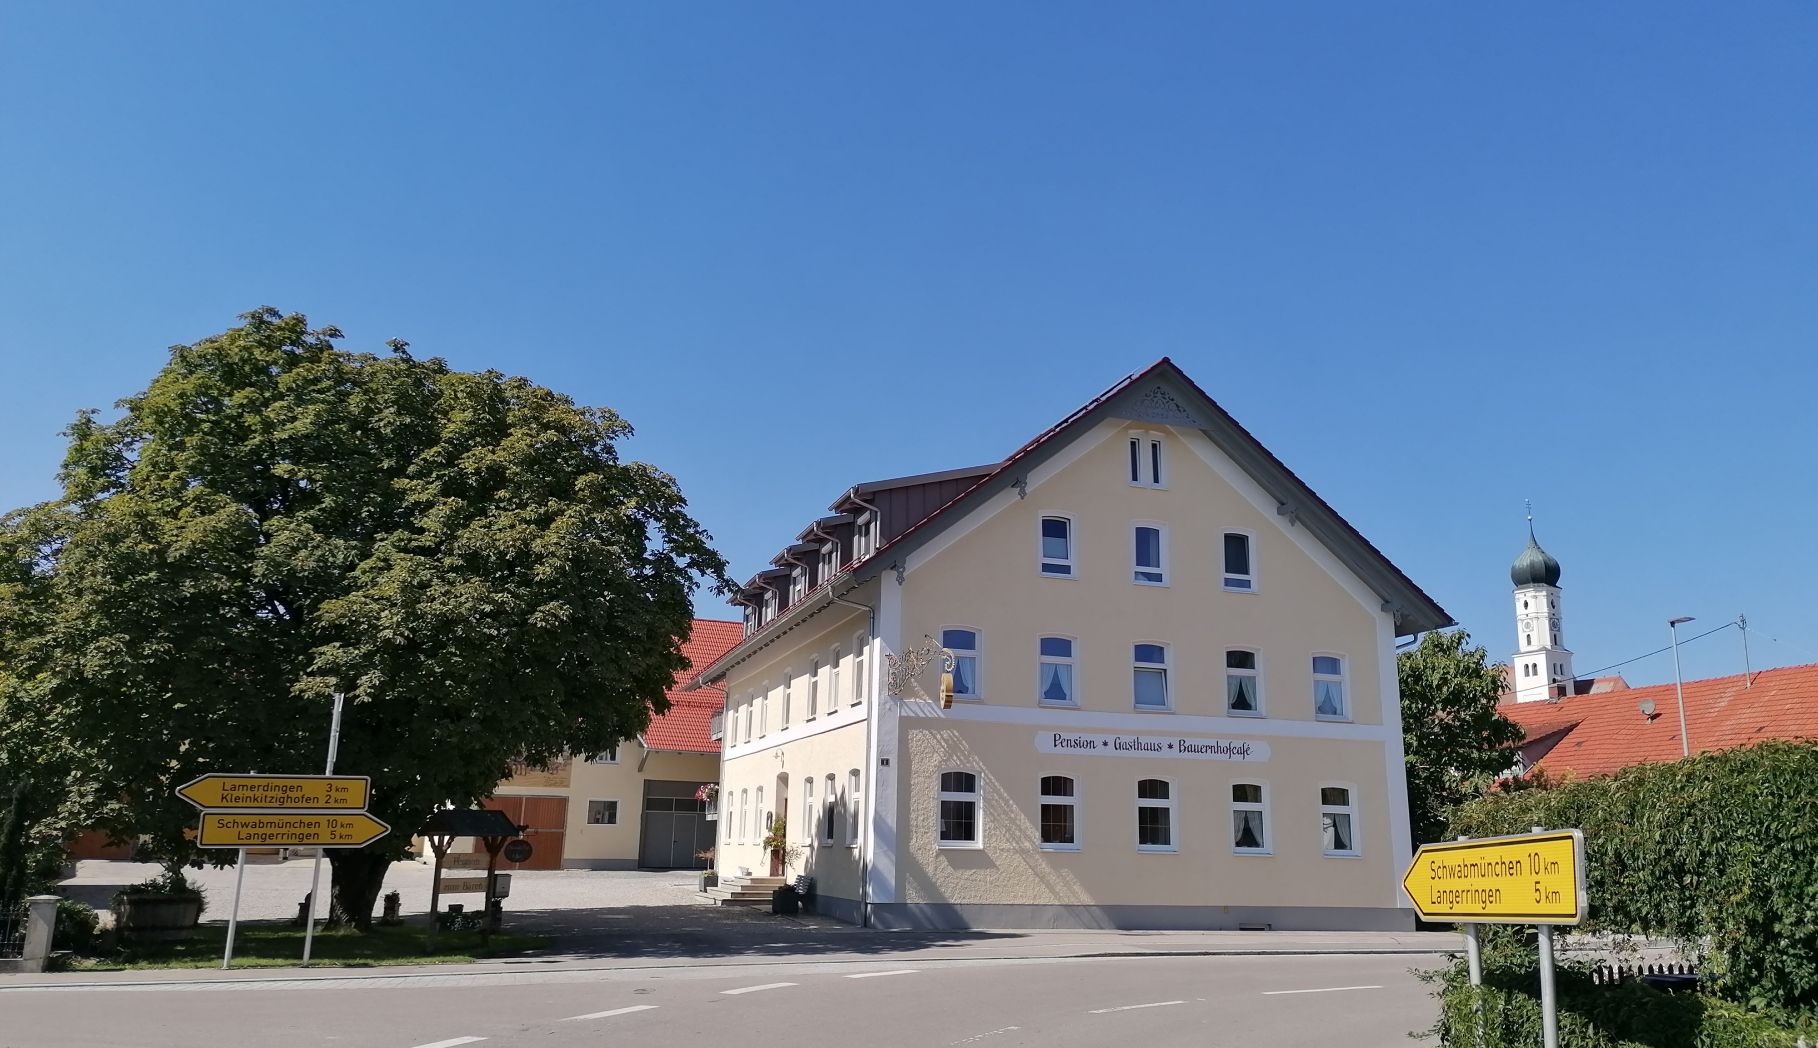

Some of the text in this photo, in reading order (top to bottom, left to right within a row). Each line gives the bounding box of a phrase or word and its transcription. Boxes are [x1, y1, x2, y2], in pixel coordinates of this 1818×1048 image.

[1053, 733, 1251, 760] Pension Gasthaus Bauernhofcafé
[222, 782, 303, 794] Lamerdingen
[326, 783, 333, 793] 3
[221, 793, 319, 806] Kleinkitzighofen
[324, 795, 331, 804] 2
[217, 818, 321, 829] Schwabmünchen
[326, 819, 338, 829] 10
[237, 831, 353, 843] Langerringen 5 km
[1430, 852, 1560, 880] Schwabmünchen 10 km
[1430, 881, 1561, 910] Langerringen 5 km
